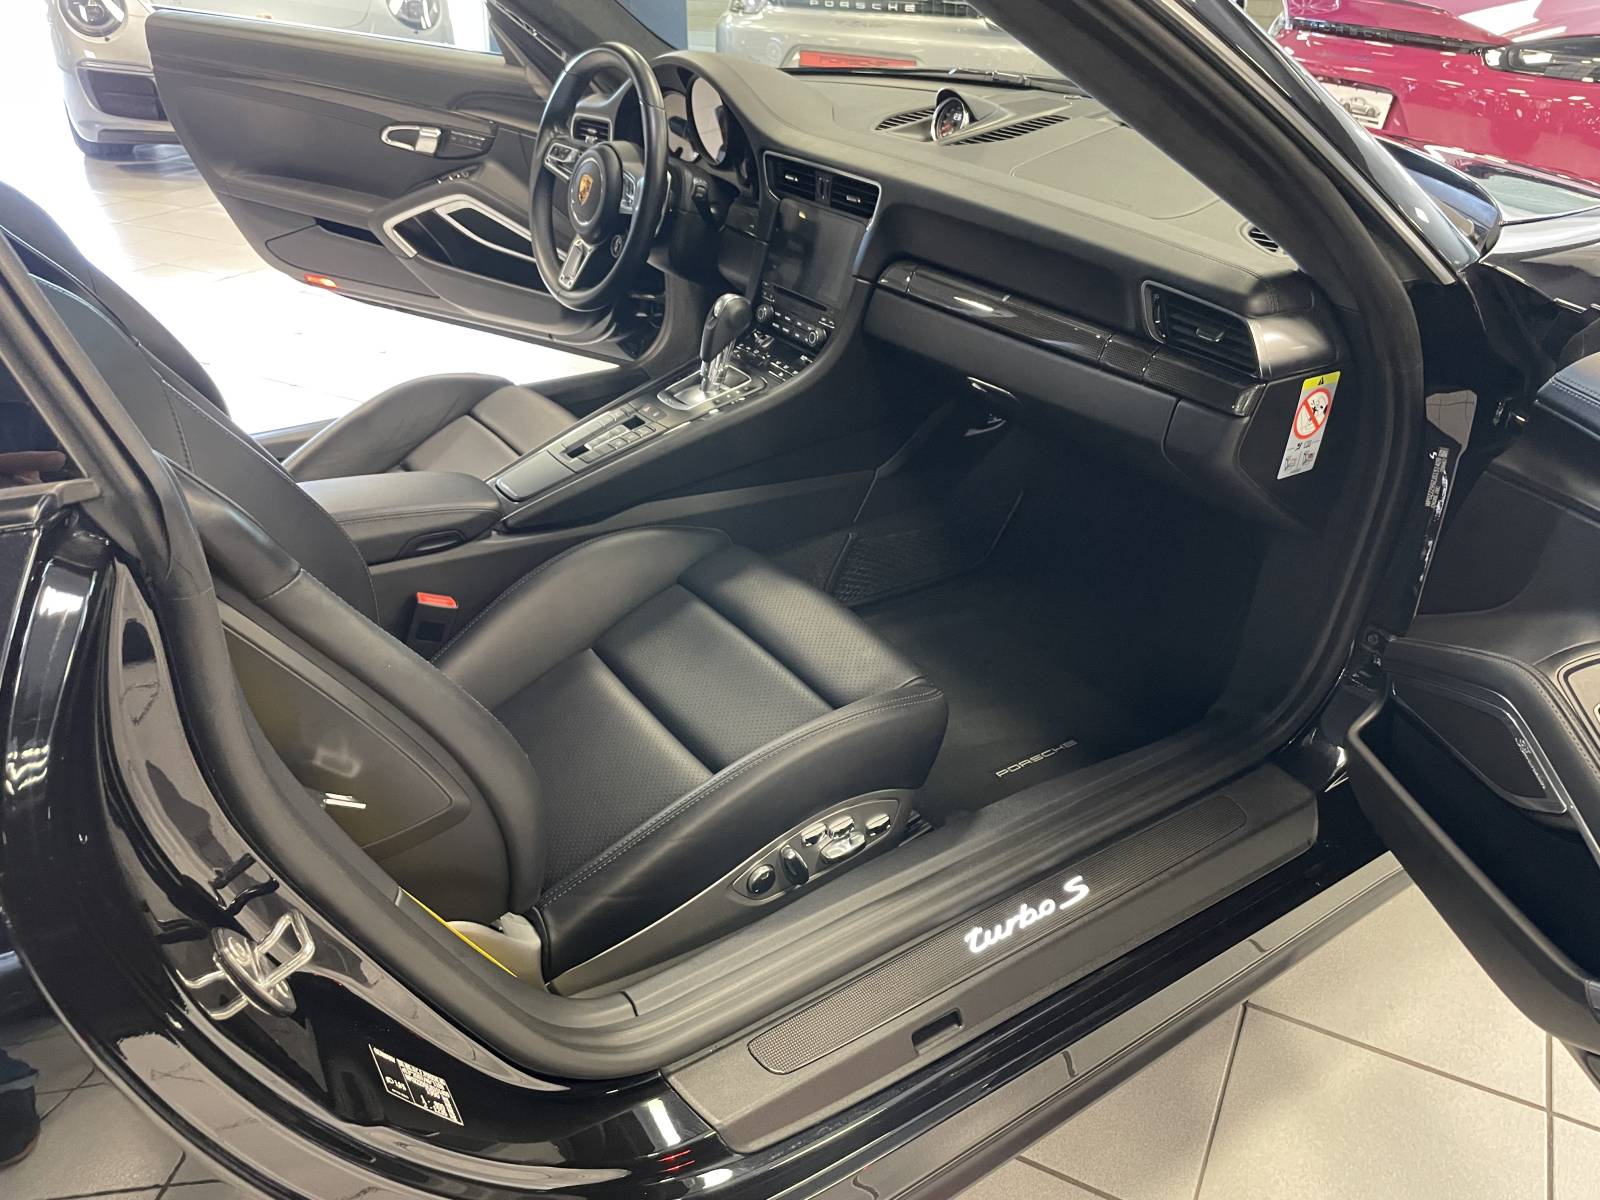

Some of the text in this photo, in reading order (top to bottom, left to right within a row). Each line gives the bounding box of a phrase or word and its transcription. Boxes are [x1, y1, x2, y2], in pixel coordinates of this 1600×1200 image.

[809, 0, 916, 13] PORSCHE
[995, 740, 1077, 778] PORSCHE
[963, 875, 1090, 954] turbo S
